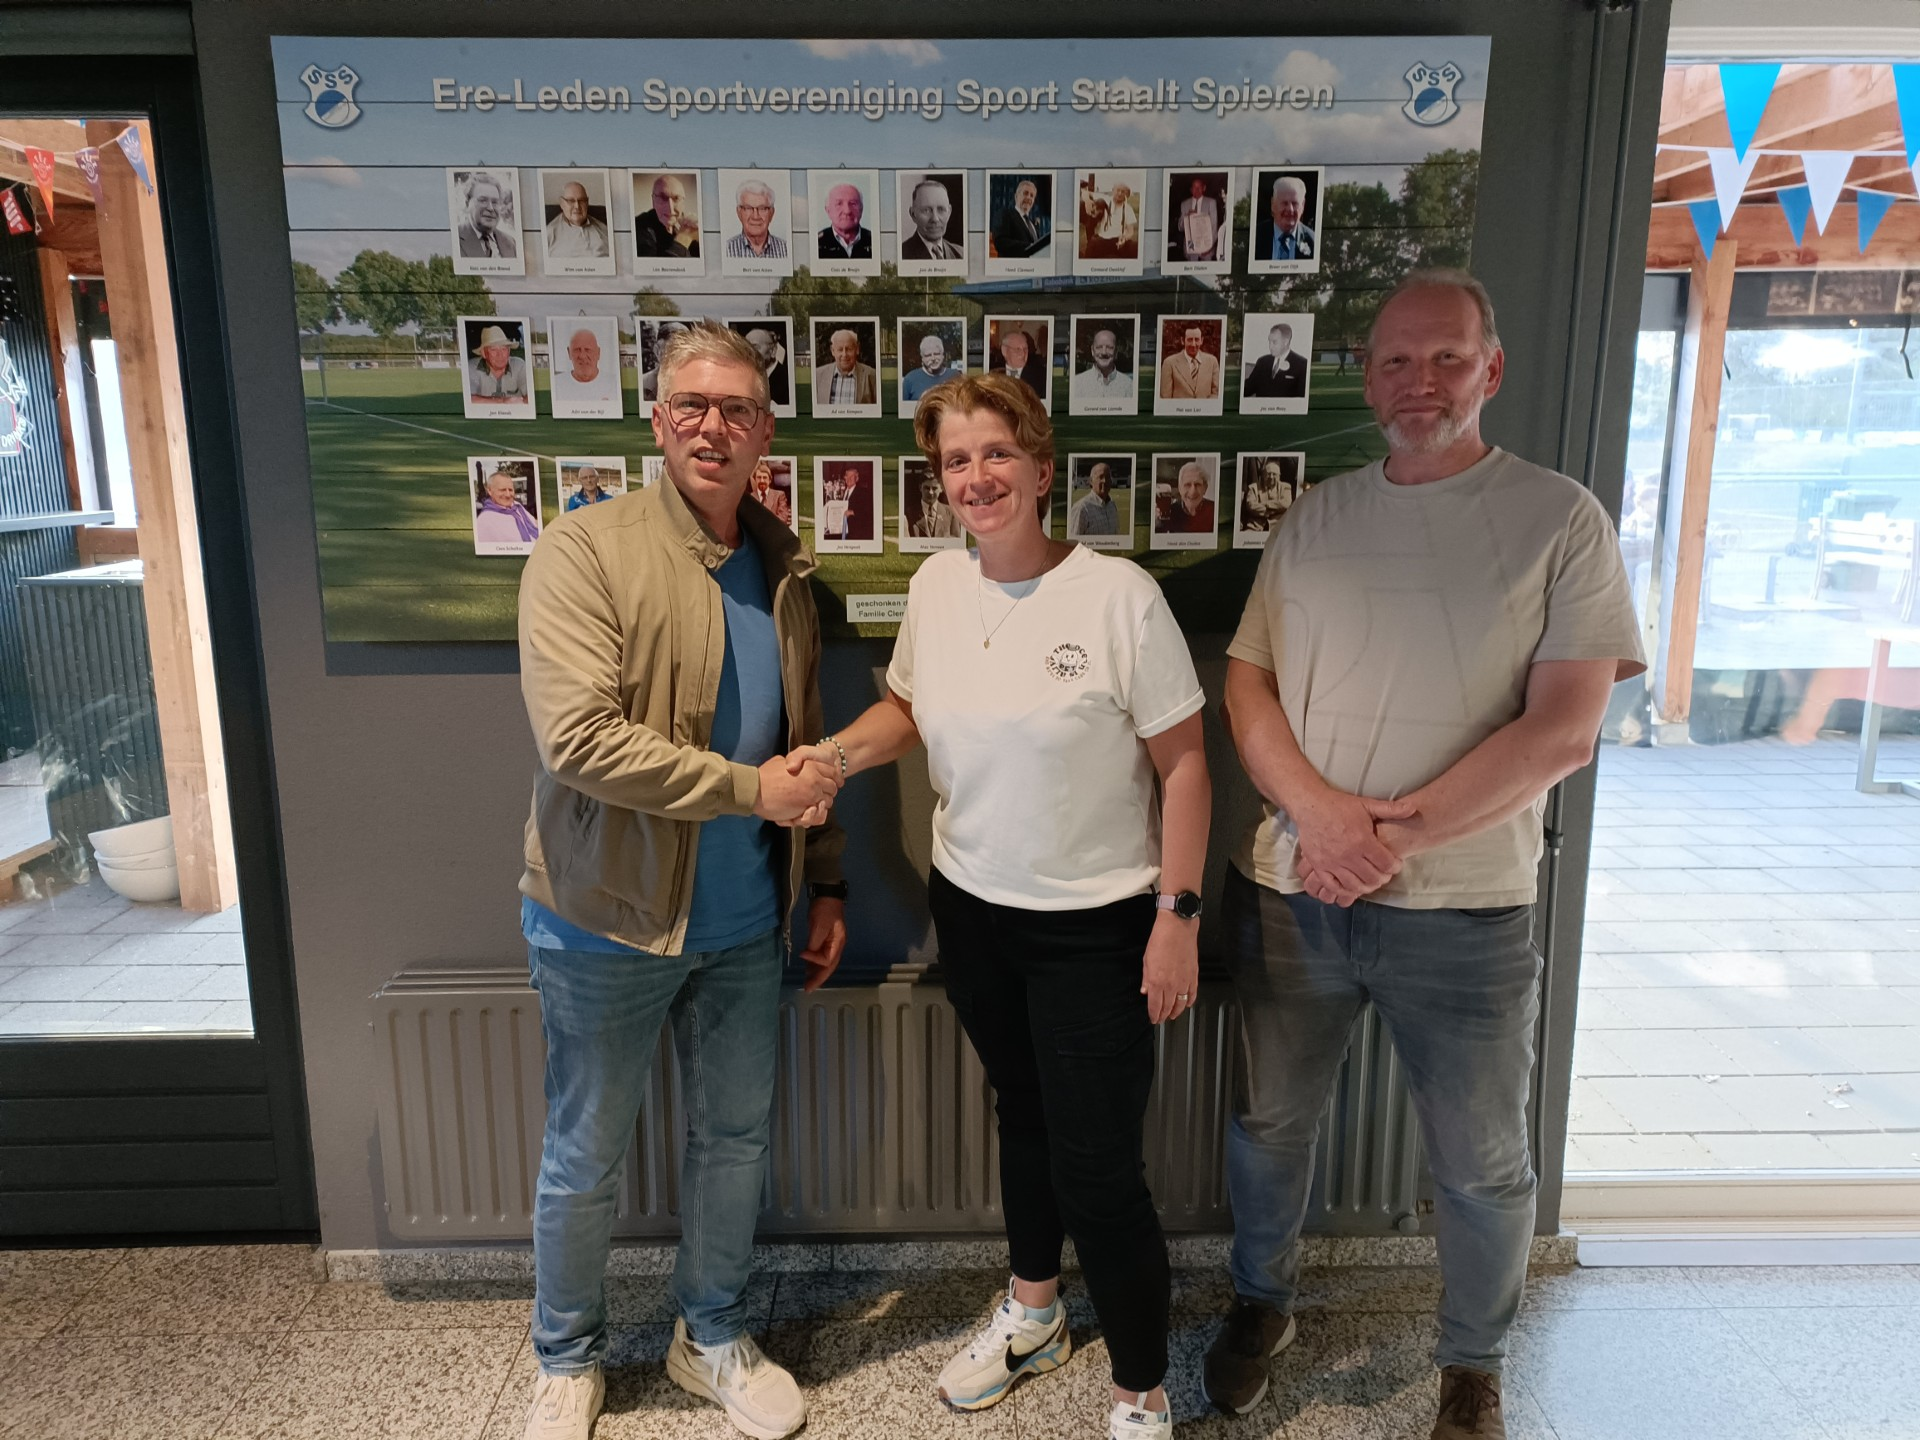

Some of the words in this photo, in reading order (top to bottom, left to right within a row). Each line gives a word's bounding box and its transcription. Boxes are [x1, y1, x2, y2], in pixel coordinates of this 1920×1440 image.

[308, 70, 353, 88] SSS
[1412, 67, 1456, 86] SSS
[433, 78, 630, 111] Ere-Leden
[643, 79, 944, 119] Sportvereniging
[957, 79, 1059, 119] Sport
[1071, 78, 1180, 111] Staalt
[1192, 77, 1334, 117] Spieren
[855, 600, 901, 609] geschonken
[1129, 1411, 1147, 1422] NIKE
